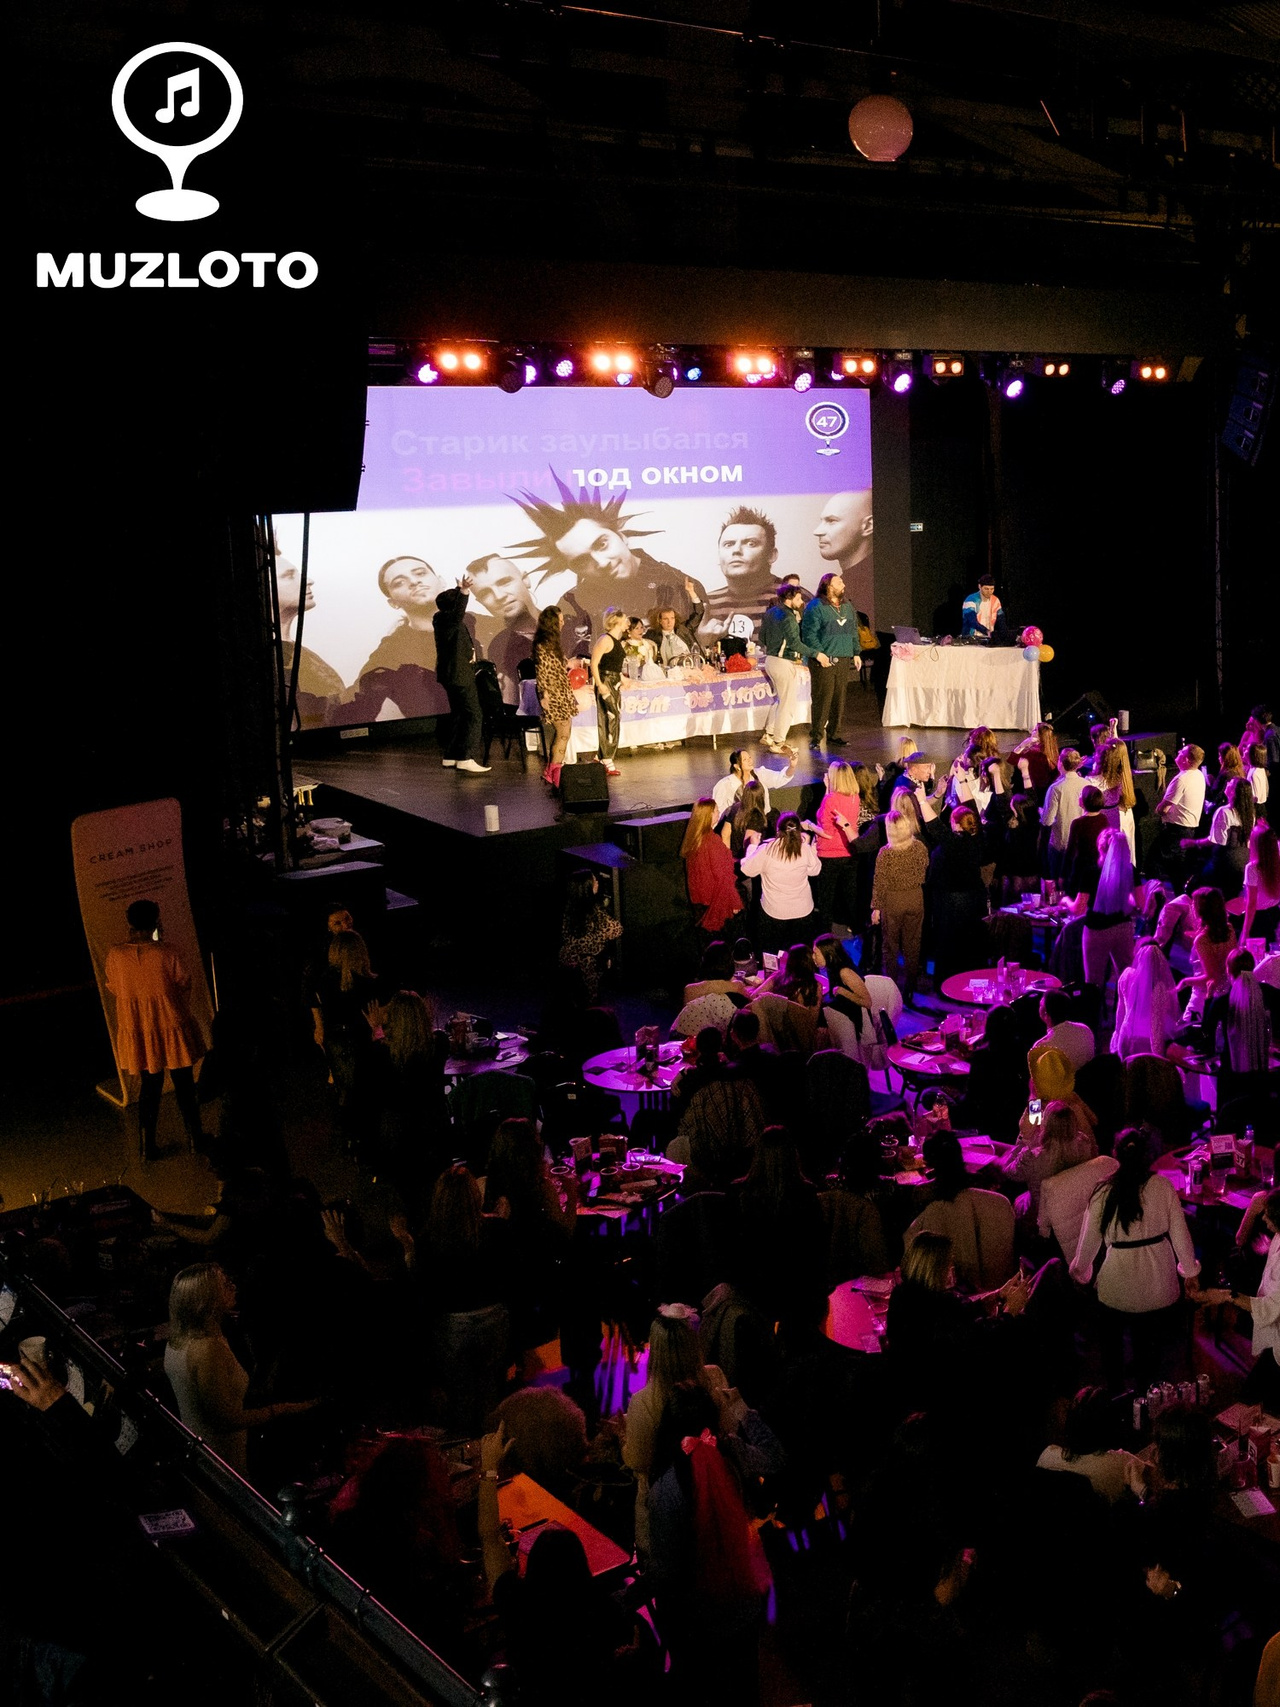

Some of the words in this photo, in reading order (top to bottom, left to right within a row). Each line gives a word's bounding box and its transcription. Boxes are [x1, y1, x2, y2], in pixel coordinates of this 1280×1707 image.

[815, 416, 838, 428] 47
[391, 429, 529, 460] Старик
[541, 426, 749, 458] заулыбался
[641, 464, 743, 486] окном
[731, 620, 746, 634] 13
[89, 847, 134, 864] CREAM
[139, 838, 172, 852] SHOP
